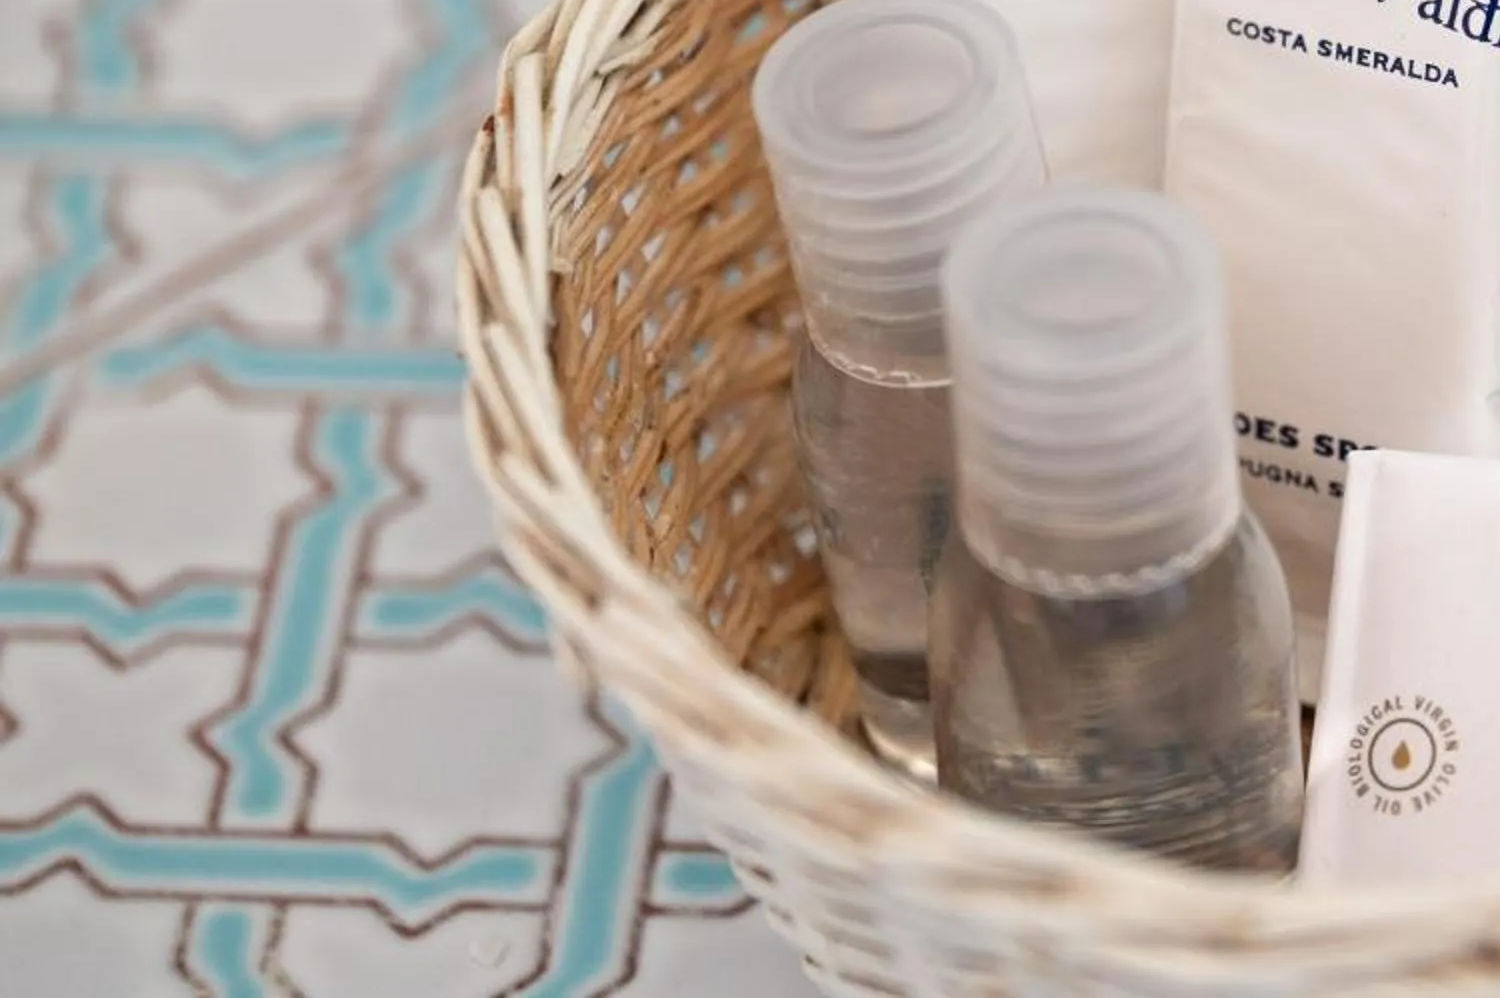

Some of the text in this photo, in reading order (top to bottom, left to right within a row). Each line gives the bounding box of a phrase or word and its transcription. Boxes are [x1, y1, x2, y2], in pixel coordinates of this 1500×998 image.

[1226, 17, 1461, 89] COSTA SMERALDA
[1347, 694, 1460, 816] BIOLOGICAL VIRGIN OLIVE OIL
